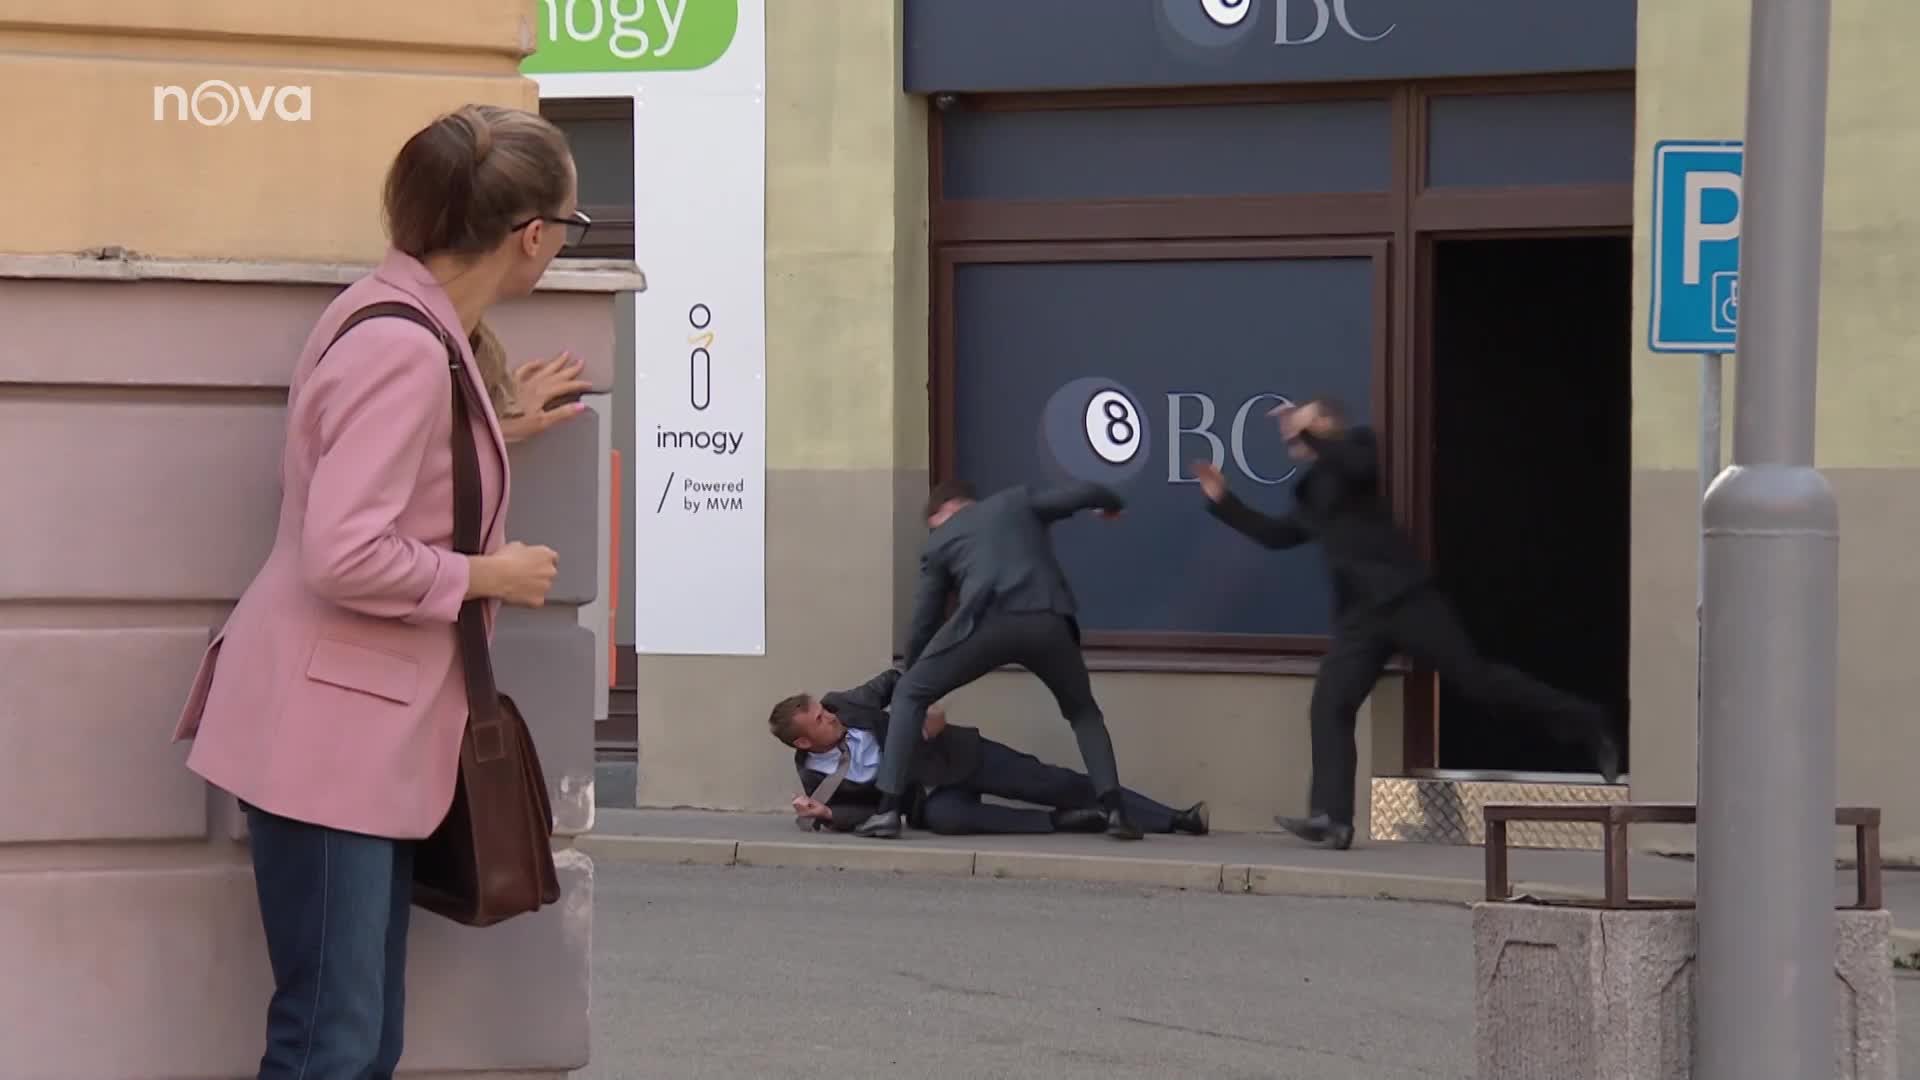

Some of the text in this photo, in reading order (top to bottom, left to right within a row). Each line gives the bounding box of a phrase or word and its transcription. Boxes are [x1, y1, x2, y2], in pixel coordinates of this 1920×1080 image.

[1683, 171, 1742, 285] P
[656, 424, 744, 455] innogy
[1103, 392, 1297, 485] 8 BC
[684, 478, 744, 493] Powered
[684, 496, 744, 513] by MVM
